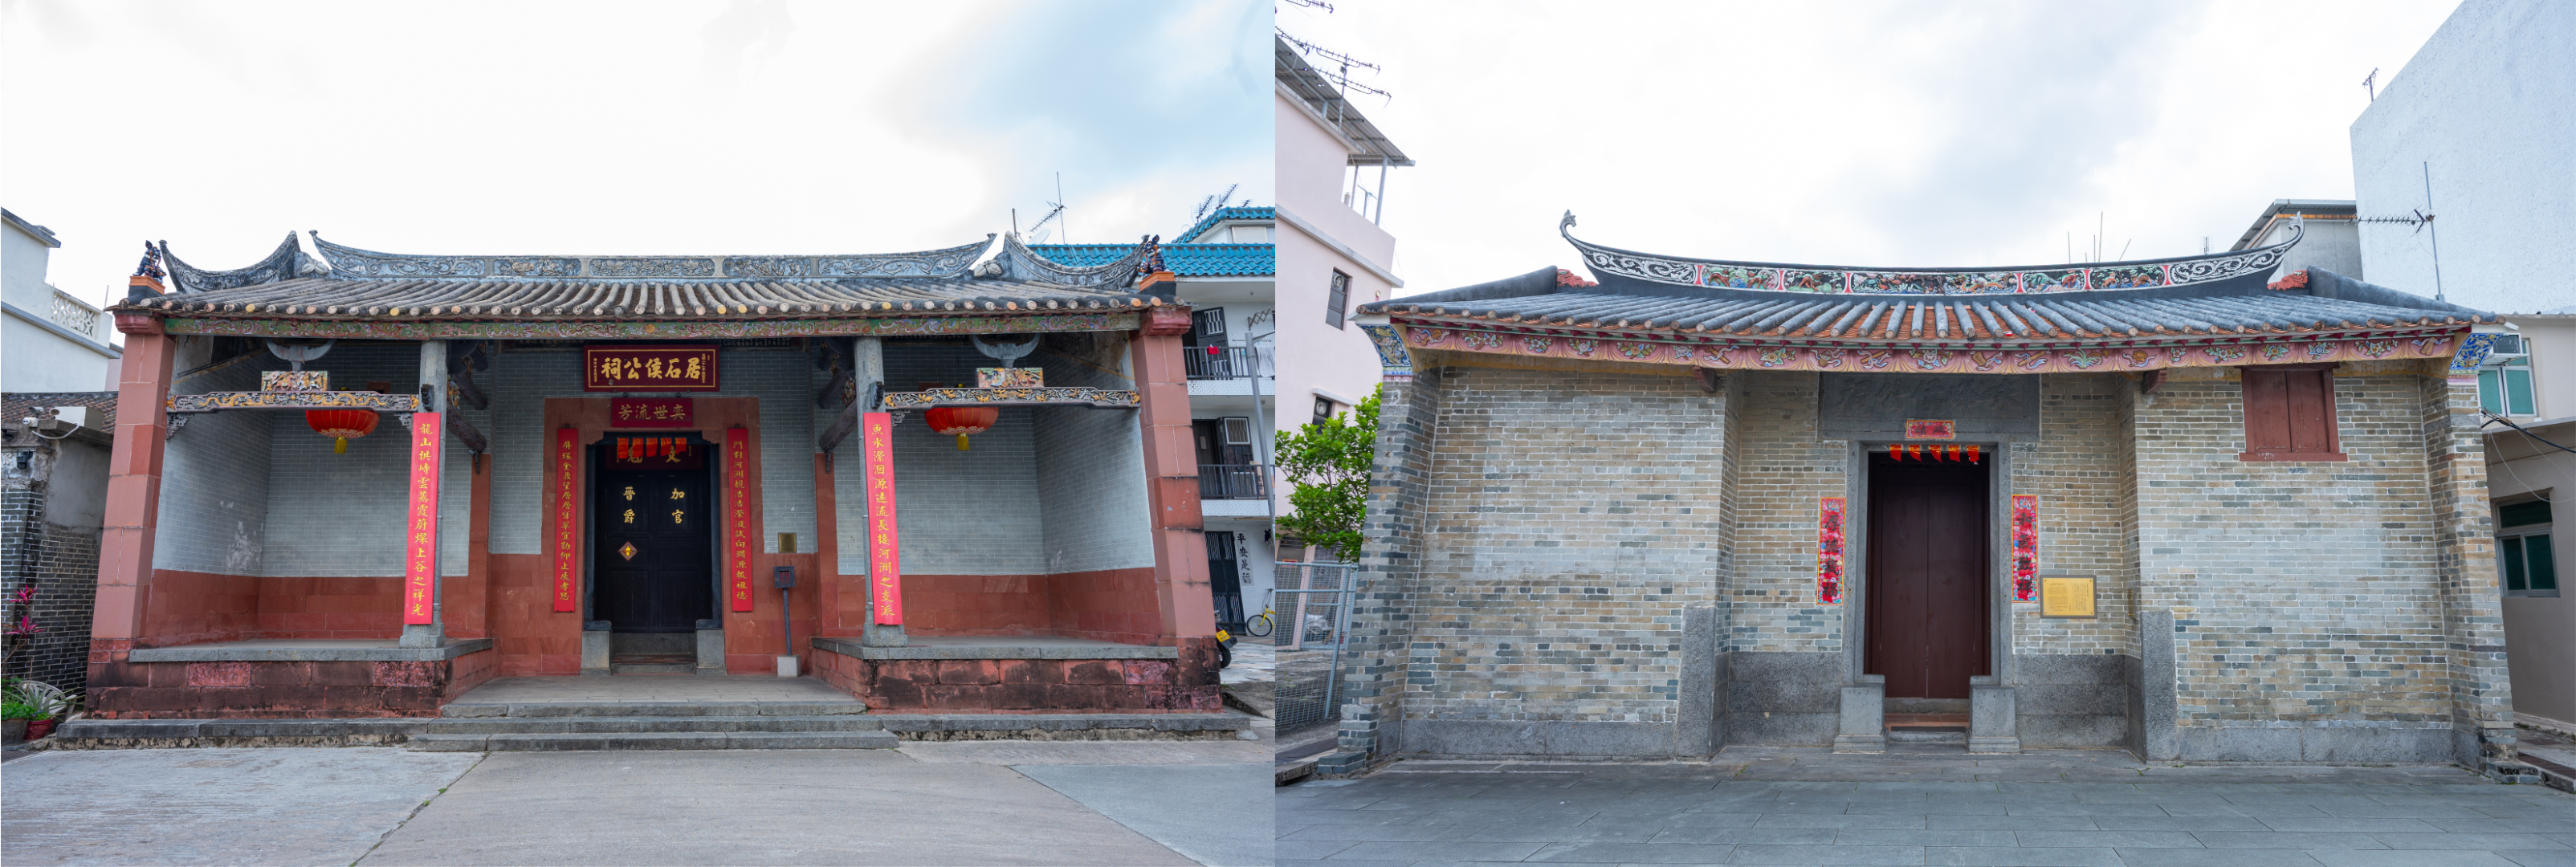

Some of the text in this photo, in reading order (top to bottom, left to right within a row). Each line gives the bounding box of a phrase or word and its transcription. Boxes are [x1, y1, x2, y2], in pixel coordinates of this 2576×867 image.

[601, 357, 701, 381] 居石侯公祠
[618, 404, 686, 421] 奕世流芳
[670, 488, 685, 523] 加官
[1237, 532, 1251, 584] 平安是福
